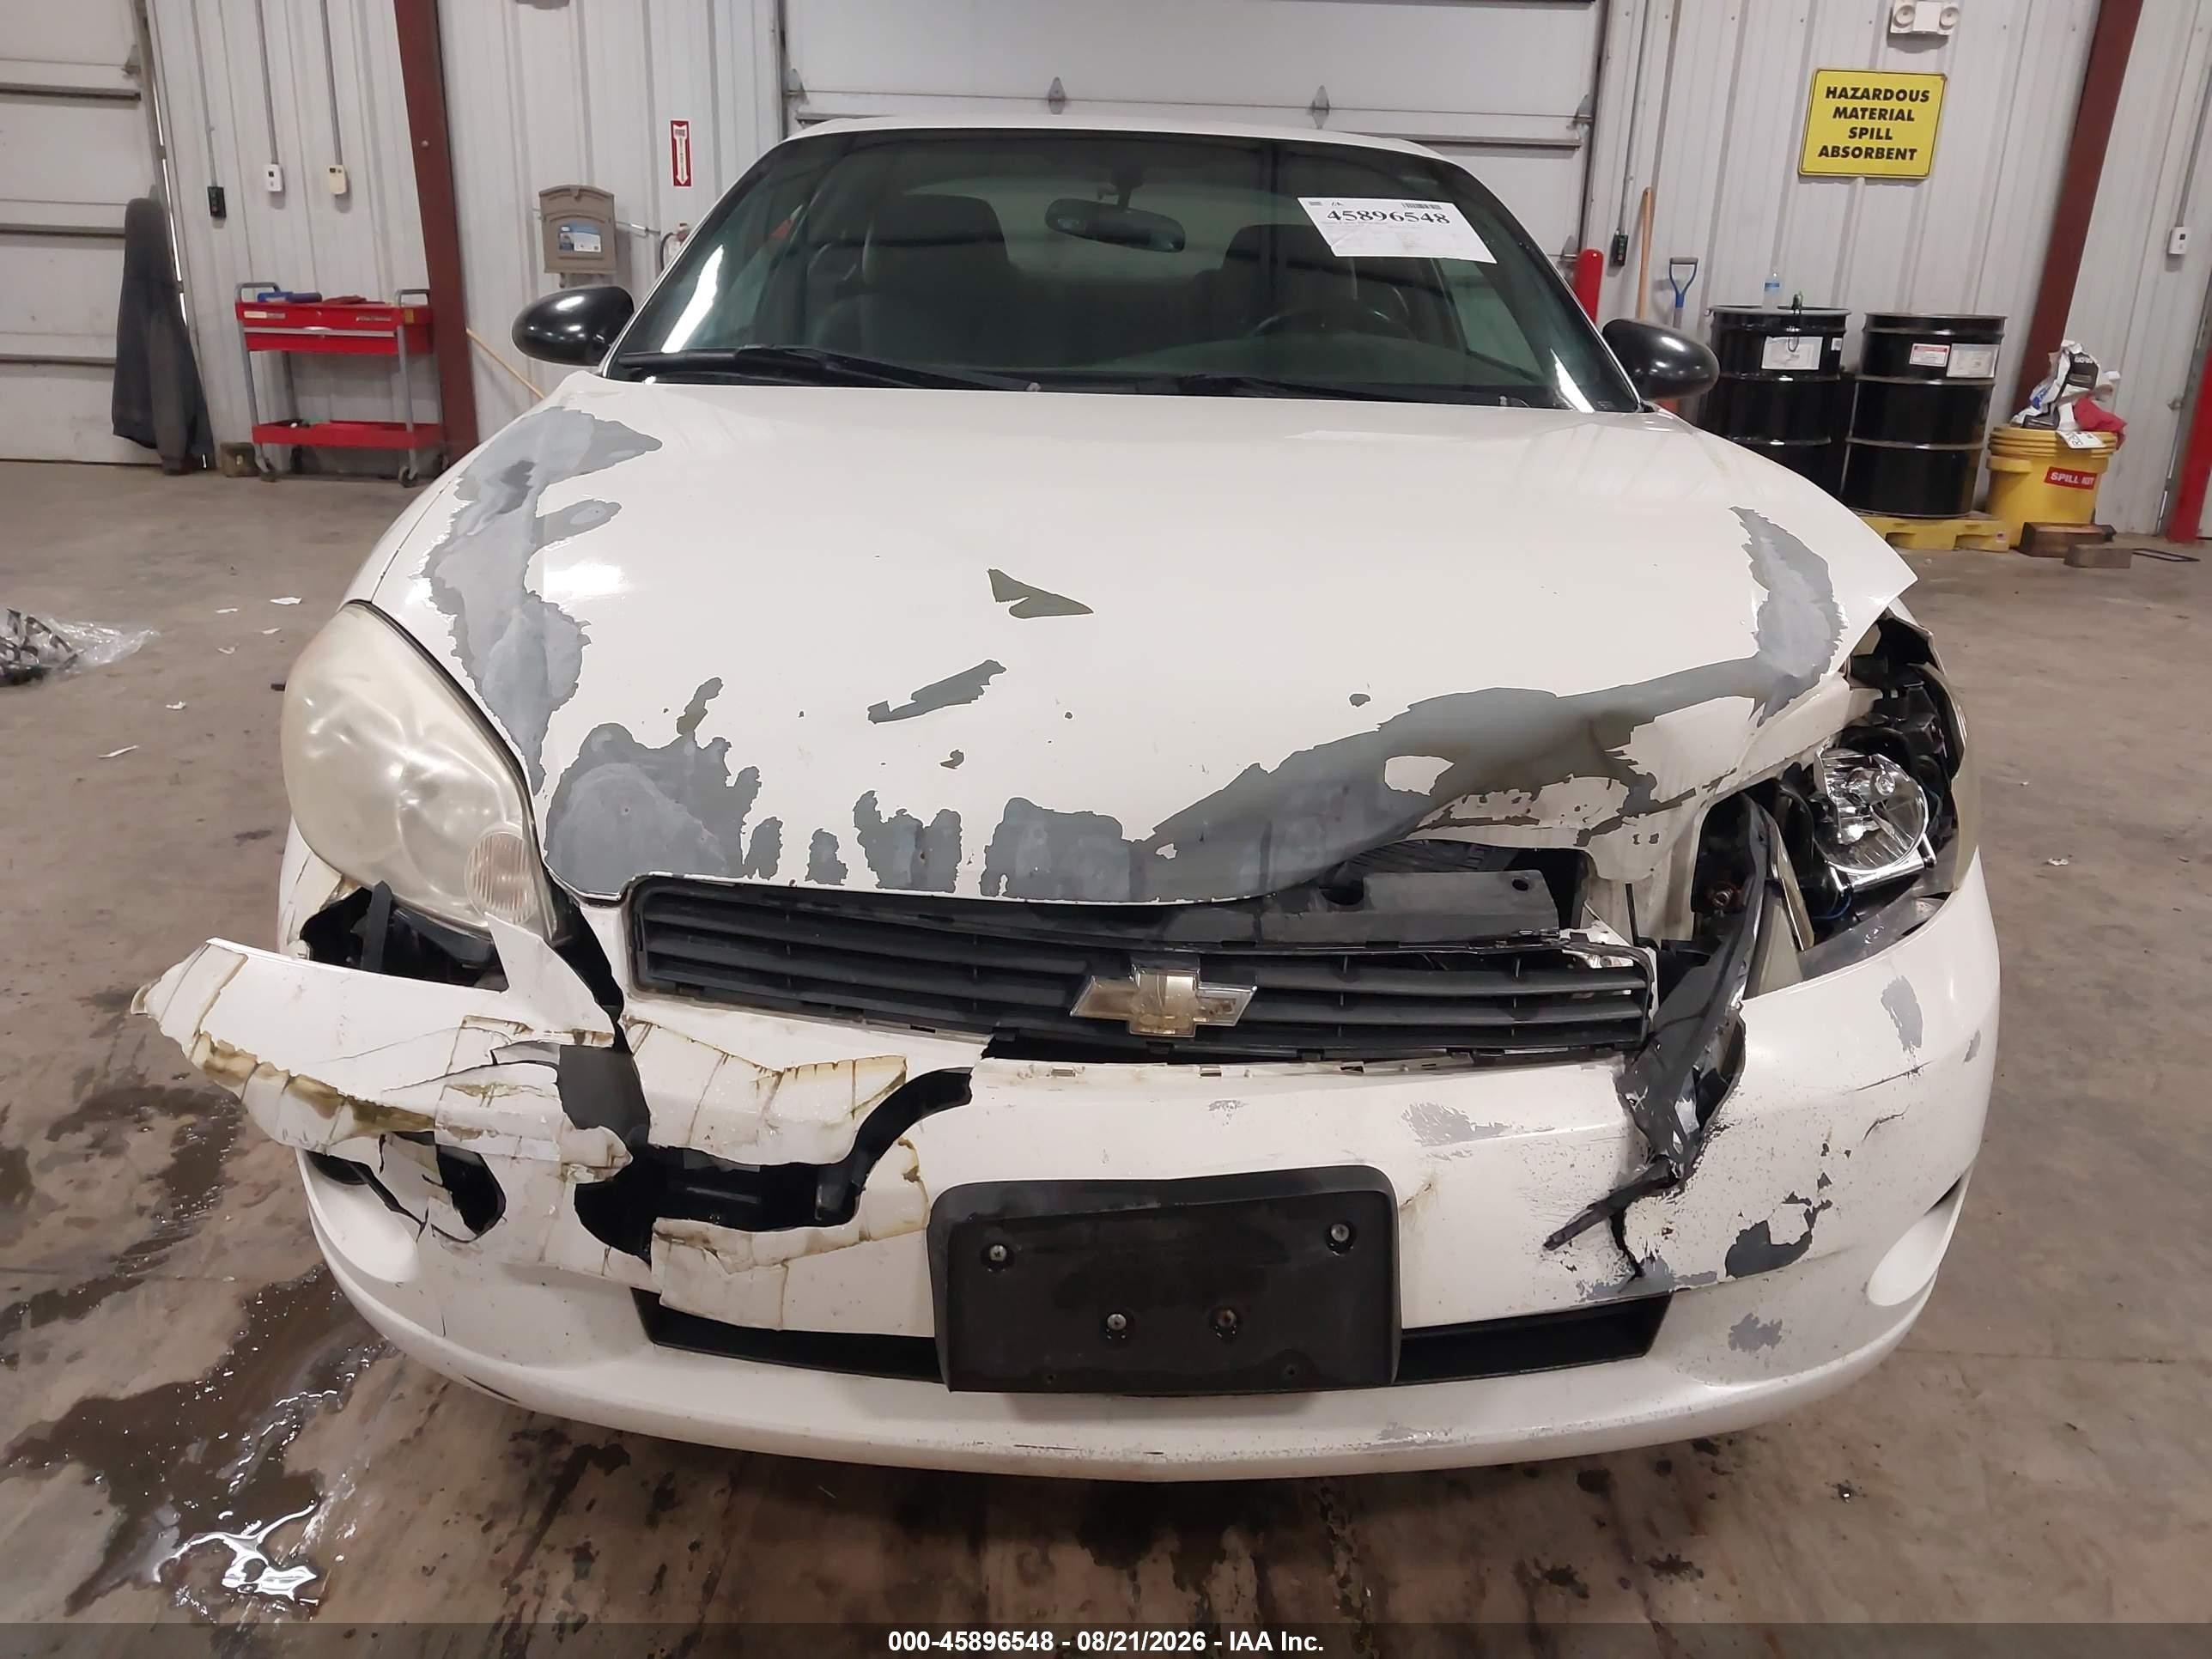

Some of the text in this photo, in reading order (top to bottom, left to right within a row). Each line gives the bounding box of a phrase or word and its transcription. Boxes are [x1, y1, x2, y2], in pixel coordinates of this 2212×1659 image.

[1826, 86, 1930, 102] HAZARDOUS
[1832, 106, 1915, 121] MATERIAL
[1848, 127, 1893, 140] SPILL
[1818, 145, 1917, 161] ABSORBENT
[1327, 210, 1450, 224] 45896548
[2050, 471, 2079, 484] SPILL
